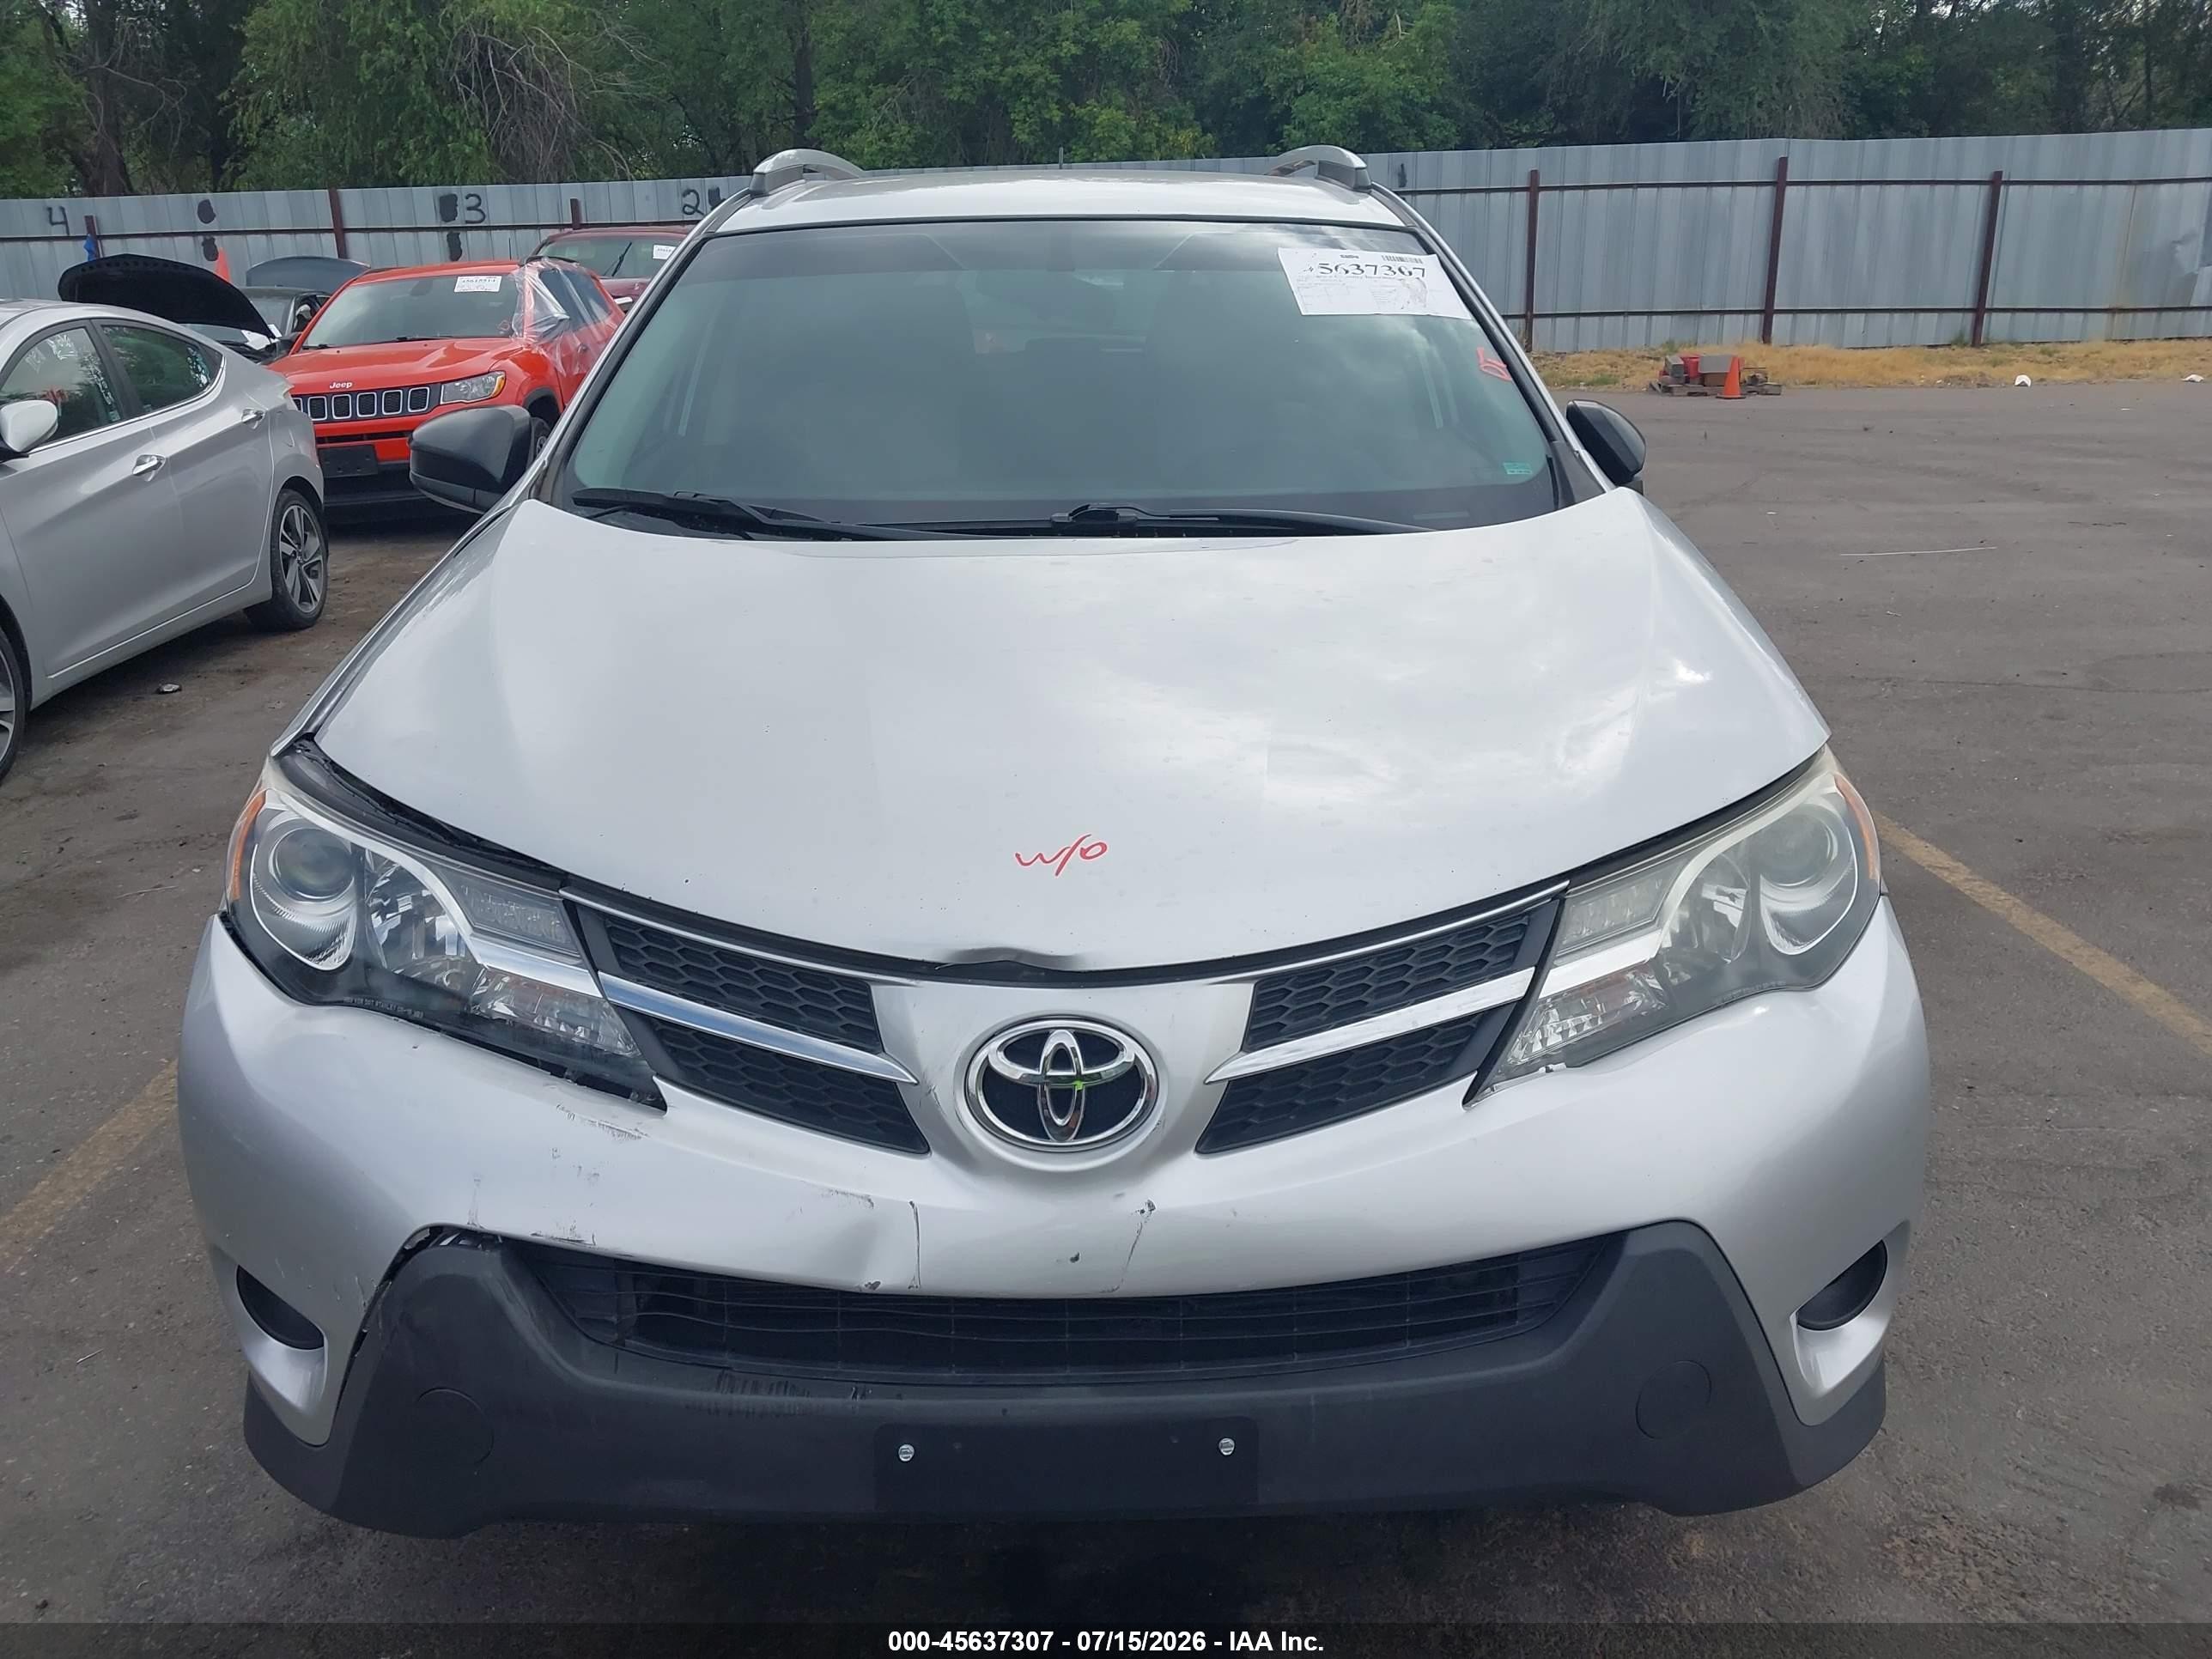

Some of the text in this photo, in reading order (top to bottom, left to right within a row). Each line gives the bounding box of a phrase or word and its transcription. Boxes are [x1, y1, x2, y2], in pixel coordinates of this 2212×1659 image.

[465, 193, 486, 223] 3
[683, 189, 705, 216] 2
[46, 206, 70, 236] 4
